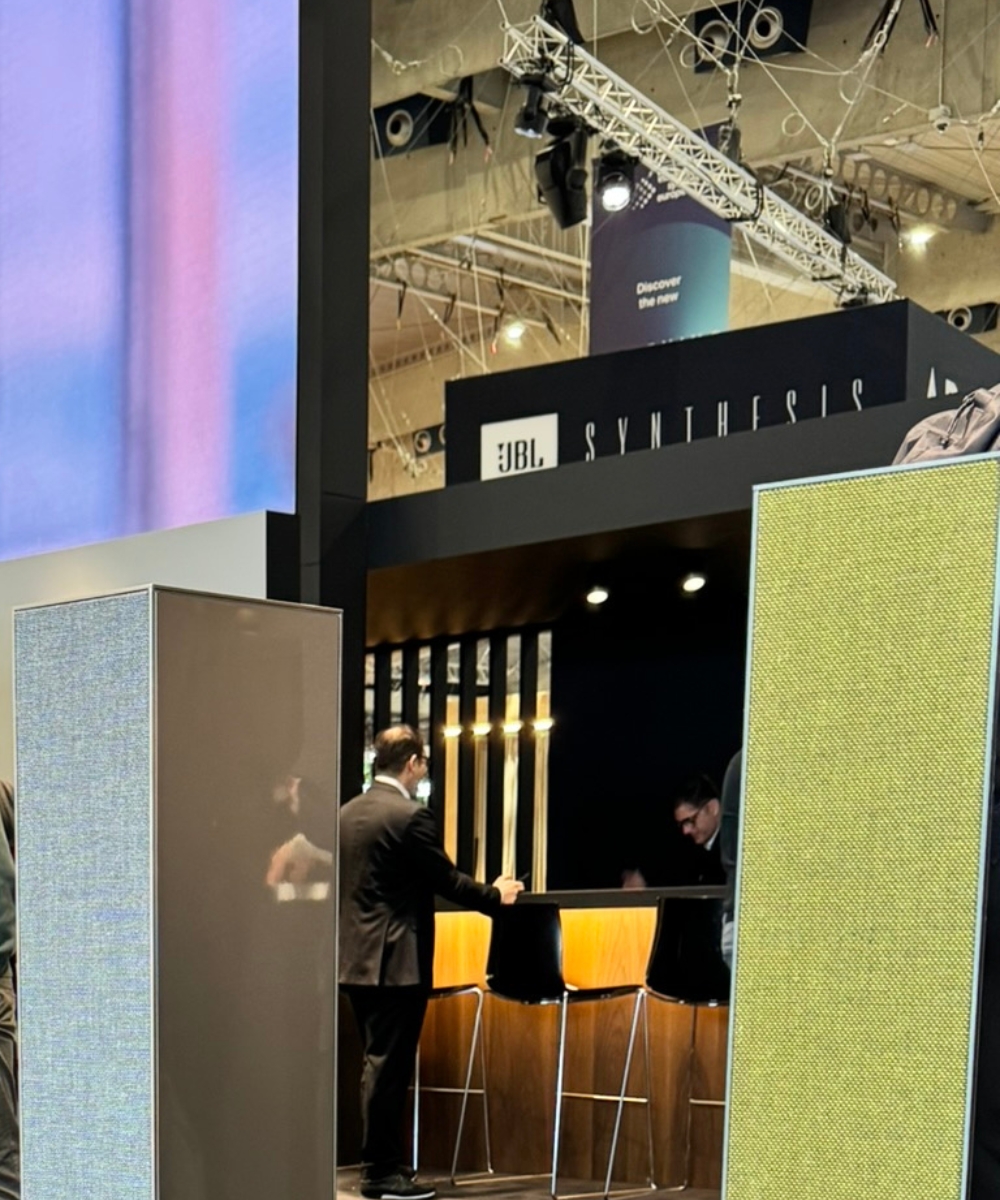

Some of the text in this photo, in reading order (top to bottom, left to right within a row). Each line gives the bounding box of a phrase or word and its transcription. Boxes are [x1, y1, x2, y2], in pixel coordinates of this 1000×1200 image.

[636, 275, 682, 296] Discover
[638, 291, 679, 310] the new
[497, 438, 544, 474] JBL
[584, 378, 863, 463] SYNTHESIS
